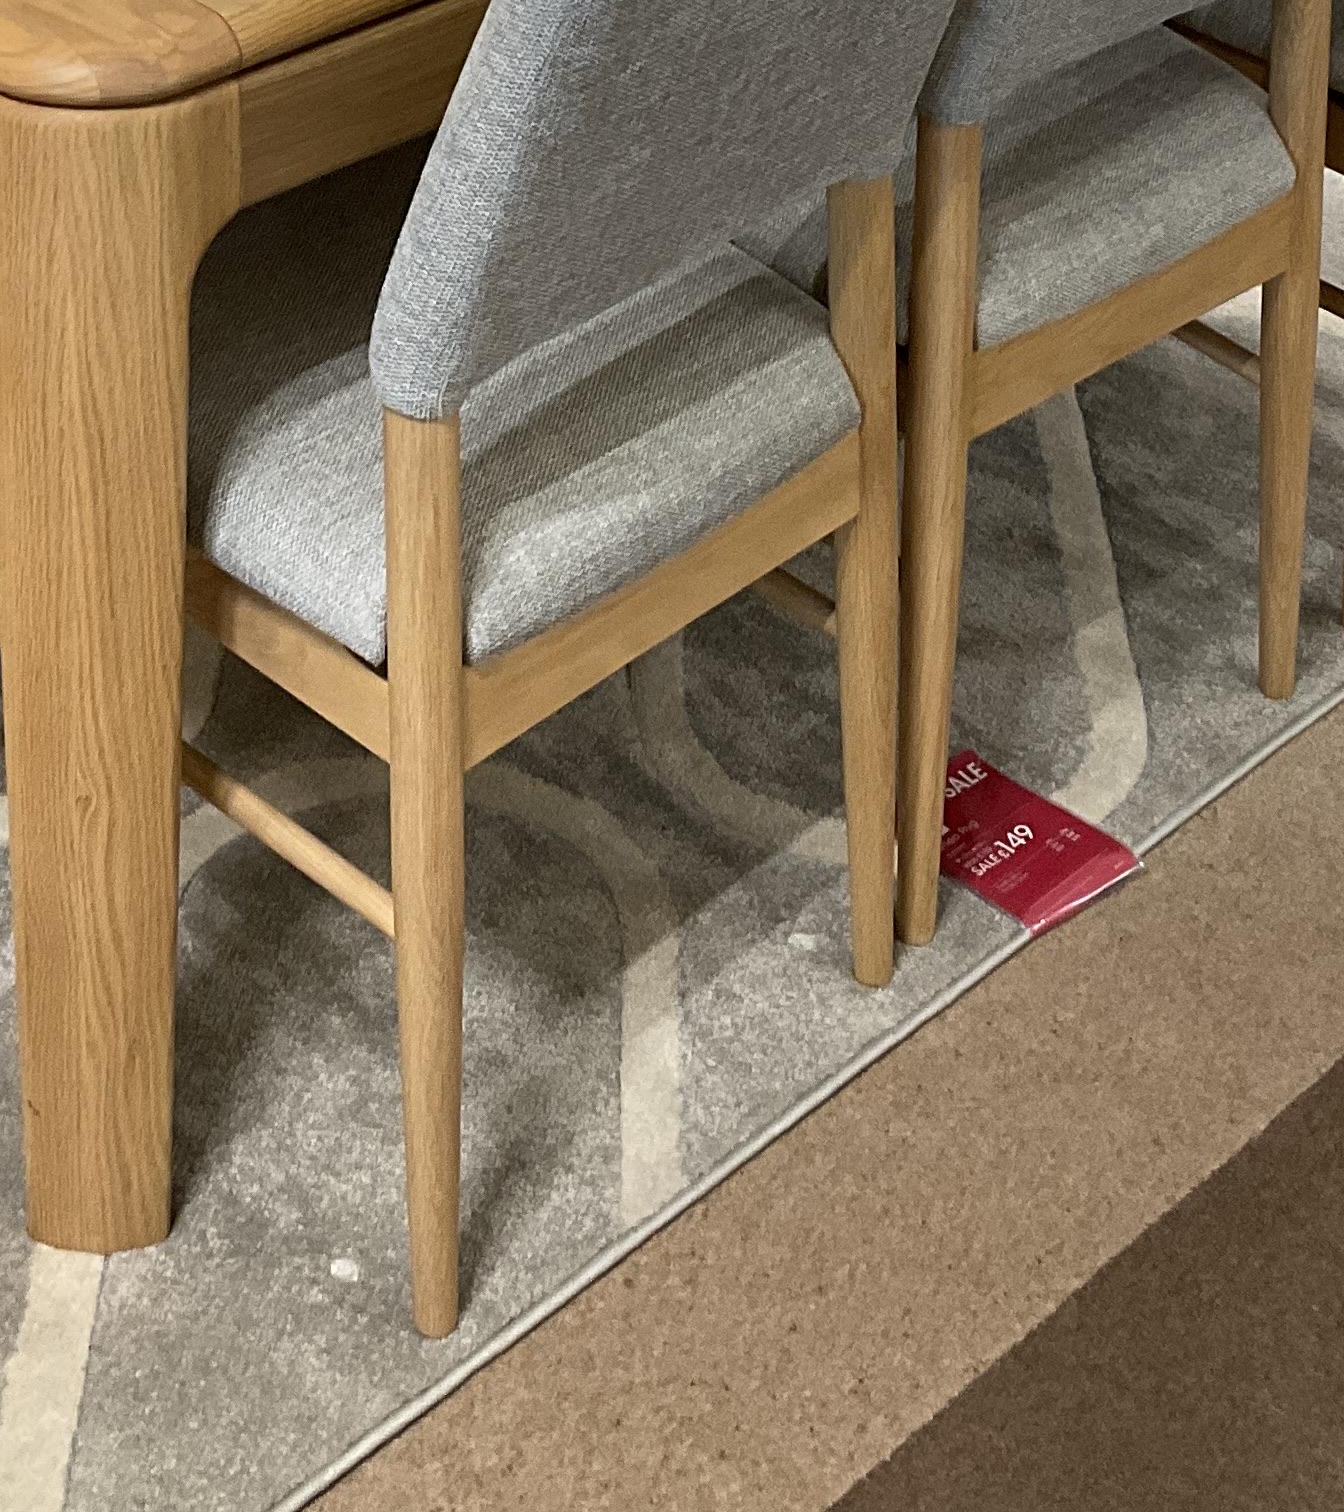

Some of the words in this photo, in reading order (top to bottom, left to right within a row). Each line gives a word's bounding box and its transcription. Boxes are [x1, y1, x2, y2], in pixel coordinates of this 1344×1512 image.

[945, 762, 988, 798] SALE
[971, 854, 1002, 876] SALE
[994, 824, 1034, 859] £149
